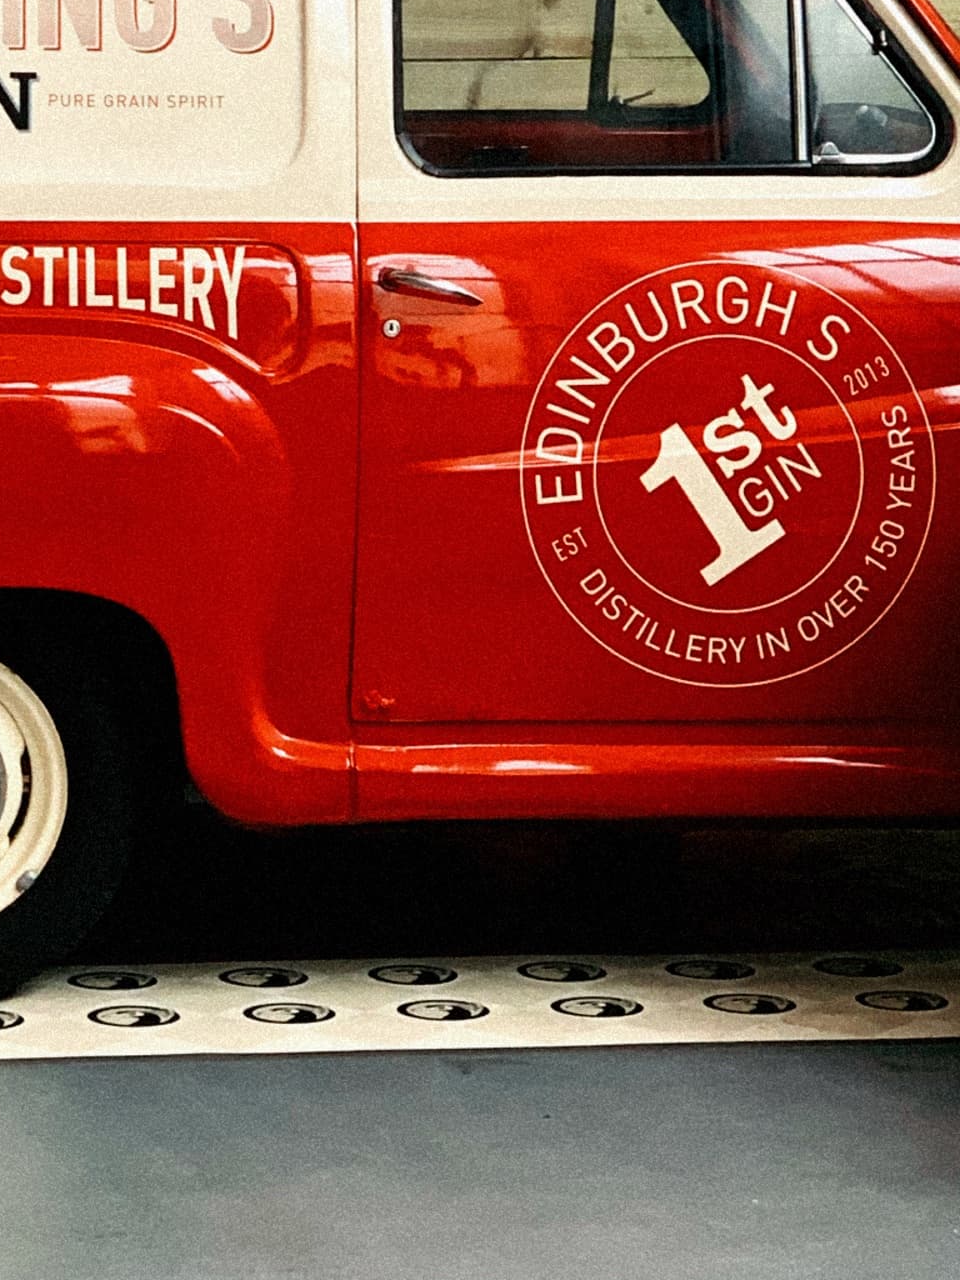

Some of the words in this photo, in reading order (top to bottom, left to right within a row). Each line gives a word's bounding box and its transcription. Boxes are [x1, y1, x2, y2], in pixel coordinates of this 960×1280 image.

[48, 94, 96, 108] PURE
[104, 94, 159, 108] GRAIN
[167, 95, 224, 109] SPIRIT
[843, 355, 890, 396] 2013
[640, 373, 798, 587] 1st
[738, 442, 822, 517] GIN
[881, 404, 917, 510] YEARS
[551, 526, 589, 562] EST
[865, 519, 906, 572] 150
[579, 568, 746, 664] DISTILLERY
[796, 574, 870, 643] OVER
[756, 627, 791, 660] IN
